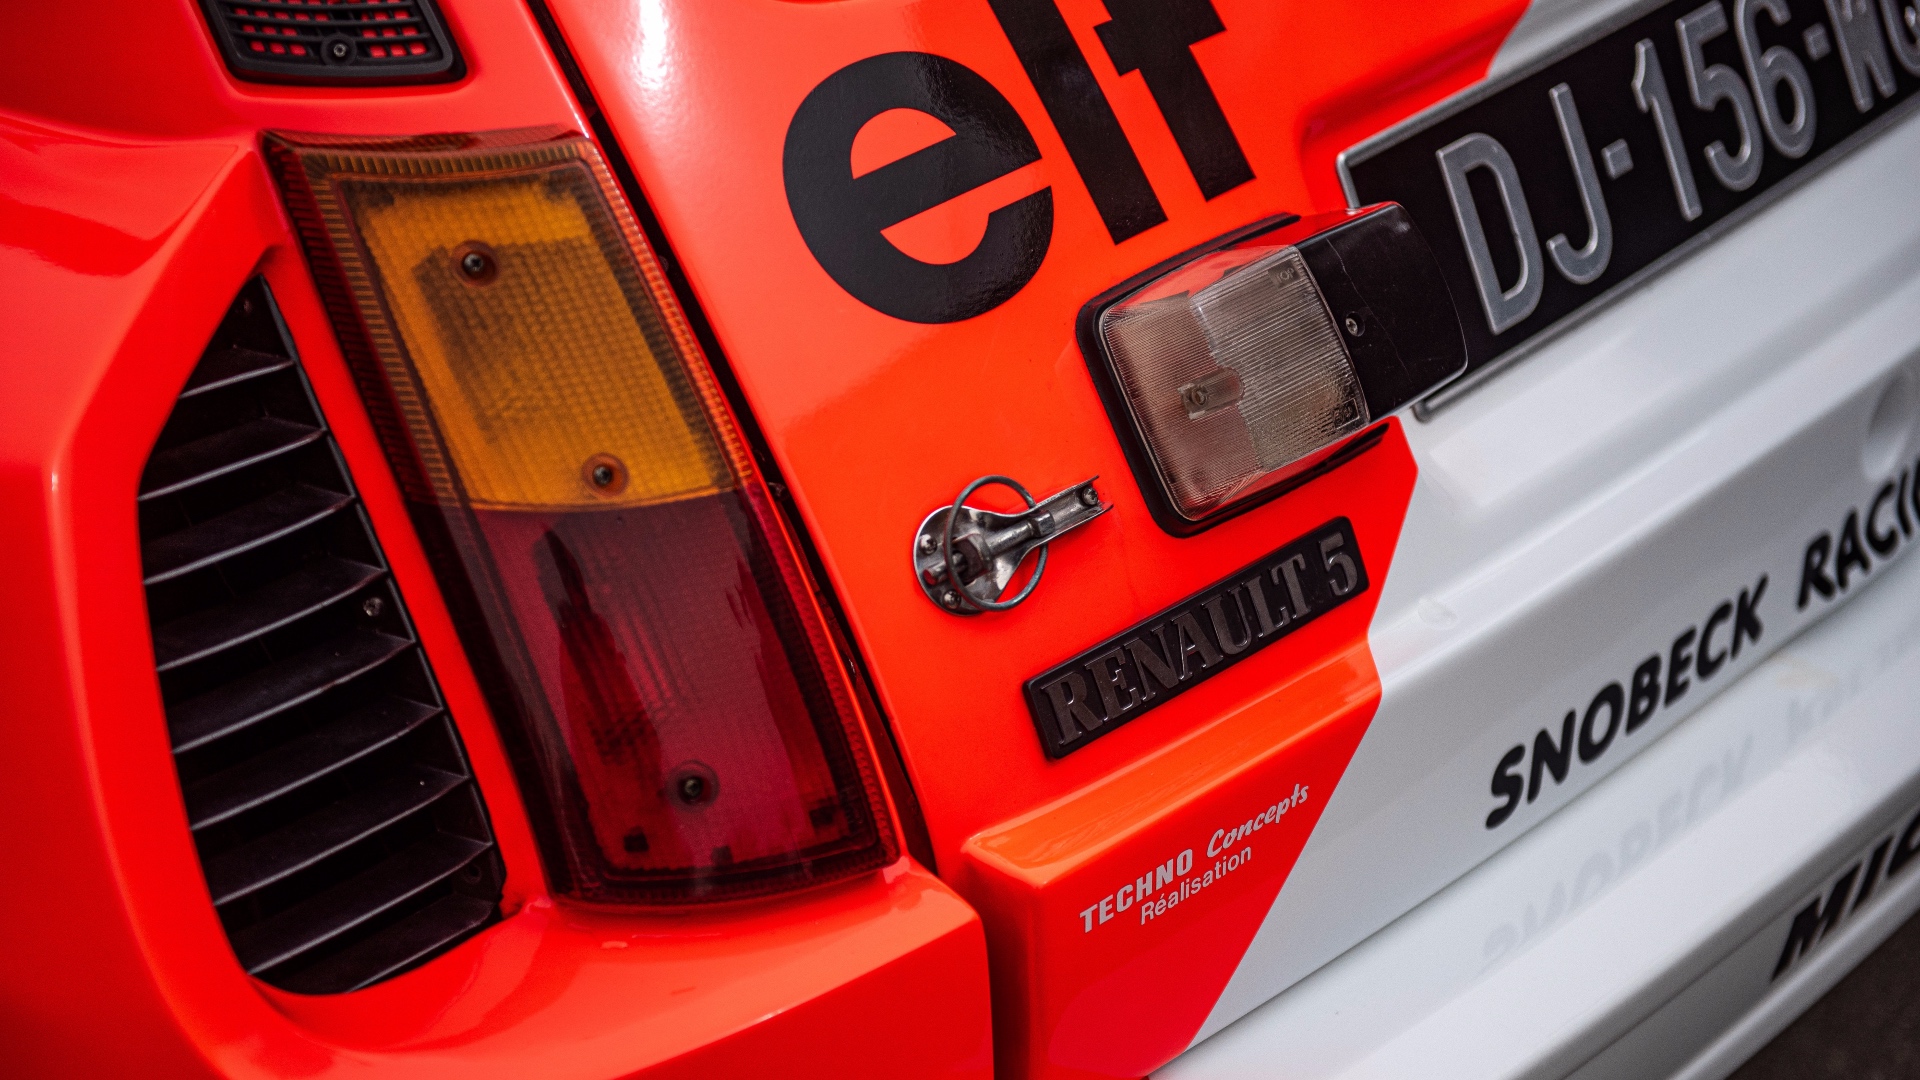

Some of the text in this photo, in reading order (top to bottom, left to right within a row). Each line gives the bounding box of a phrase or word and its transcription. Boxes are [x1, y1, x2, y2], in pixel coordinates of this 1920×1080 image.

[782, 0, 1257, 325] elf
[1042, 531, 1359, 746] RENAULT 5
[1484, 456, 1920, 831] SNOBECK RACI
[1079, 783, 1310, 934] TECHNO Concepts
[1140, 845, 1252, 926] Réalisation
